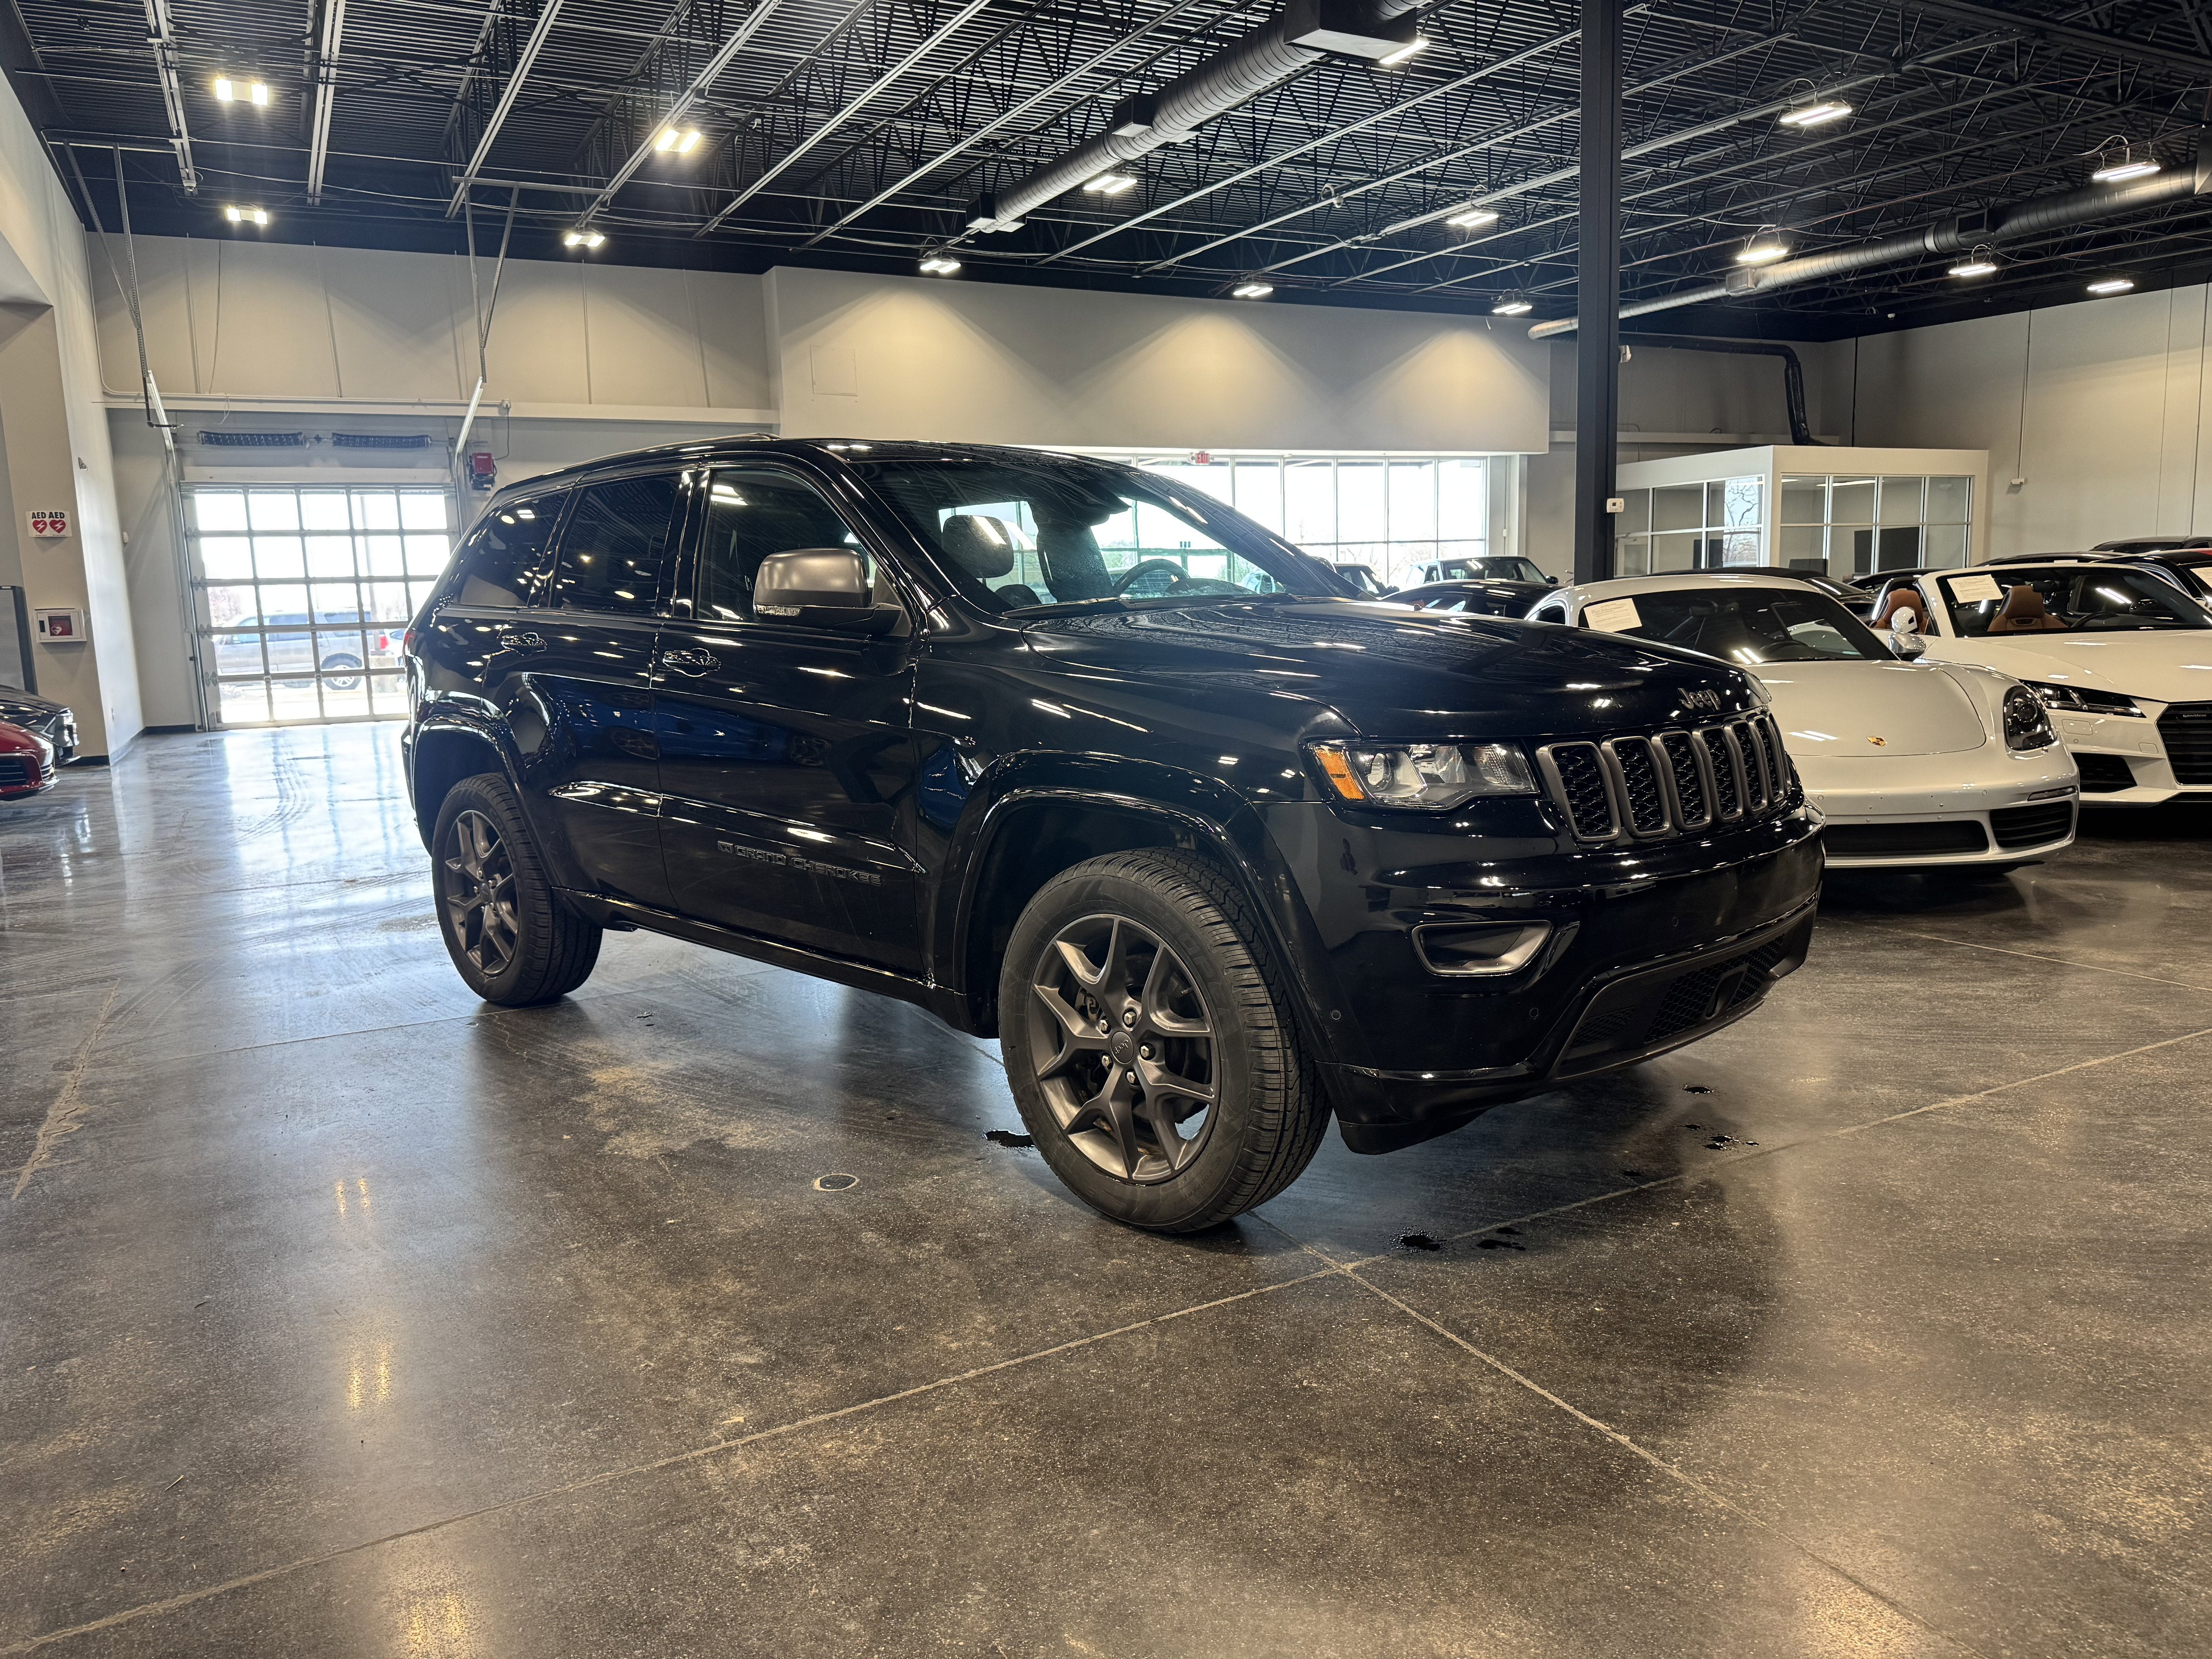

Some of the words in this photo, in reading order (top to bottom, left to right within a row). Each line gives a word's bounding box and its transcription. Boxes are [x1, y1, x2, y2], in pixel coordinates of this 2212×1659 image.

[1678, 688, 1721, 711] Jeep
[734, 845, 787, 866] GRAND
[791, 857, 883, 886] CHEROKEE
